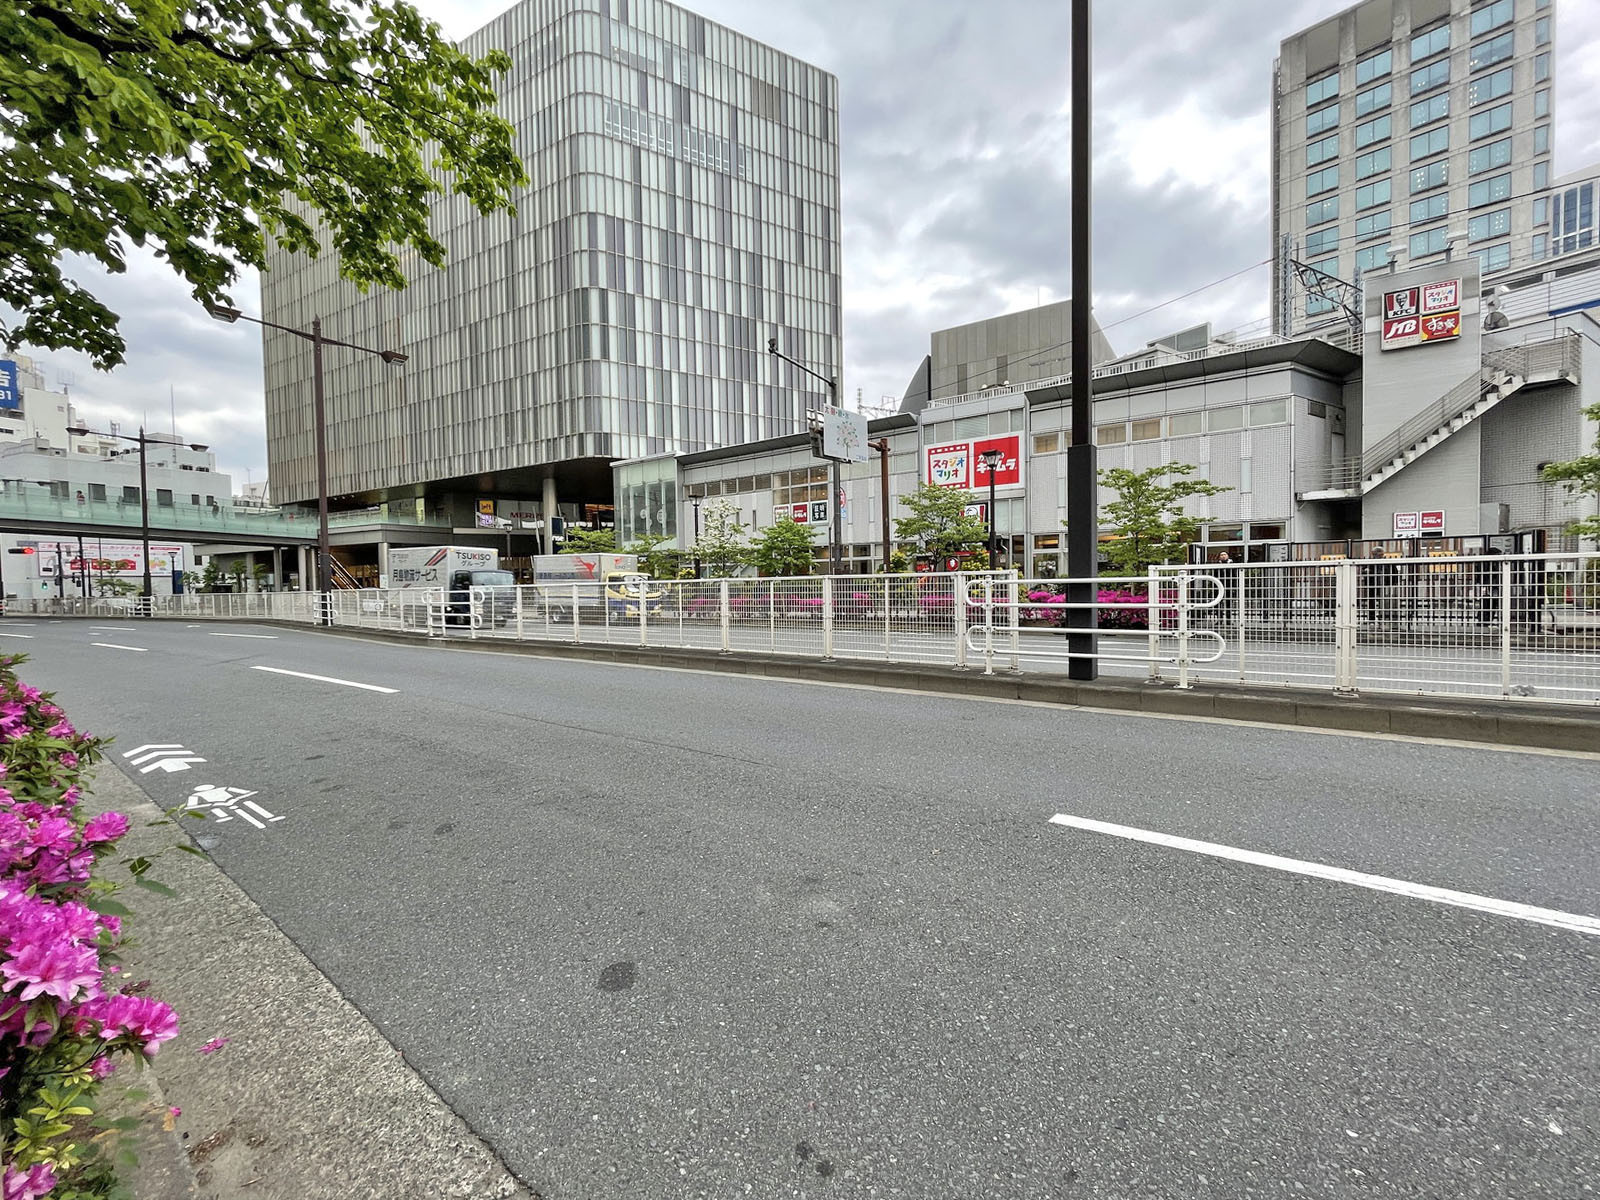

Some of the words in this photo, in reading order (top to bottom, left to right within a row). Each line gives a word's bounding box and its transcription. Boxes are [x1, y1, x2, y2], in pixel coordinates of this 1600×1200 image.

[1392, 308, 1411, 317] KFC
[1385, 319, 1417, 340] JTB
[932, 457, 965, 469] スタジオ
[976, 458, 1017, 474] キムラ
[936, 468, 959, 480] マリオ
[456, 551, 492, 561] TSUKISO
